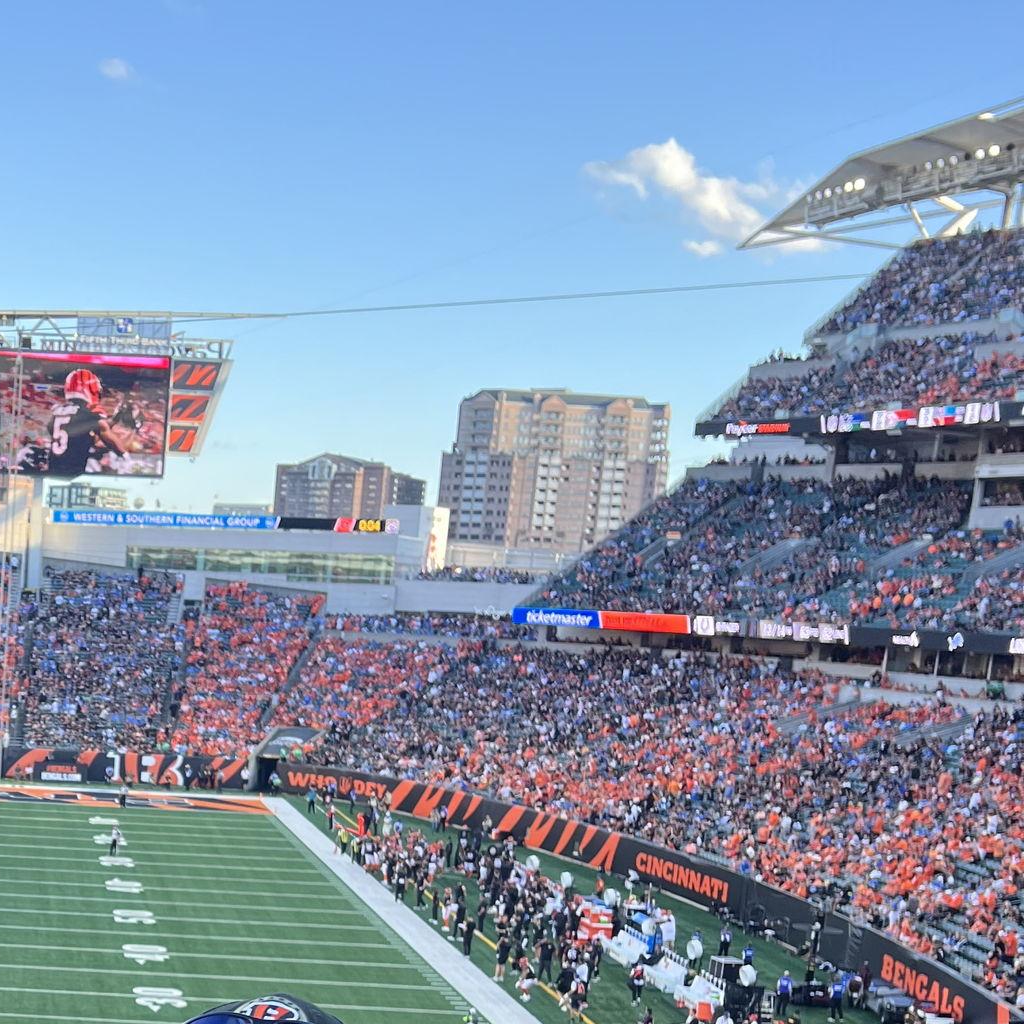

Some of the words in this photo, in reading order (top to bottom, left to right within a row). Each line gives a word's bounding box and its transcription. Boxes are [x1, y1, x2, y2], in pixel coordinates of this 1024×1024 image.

[51, 404, 80, 455] 5
[73, 513, 114, 522] WESTERN
[117, 515, 123, 523] &
[125, 514, 174, 524] SOUTHERN
[176, 516, 225, 526] FINANCIAL
[227, 518, 261, 527] GROUP
[526, 610, 593, 626] ticketmaster
[635, 851, 729, 903] CINCINNATI
[880, 953, 965, 1024] BENGALS
